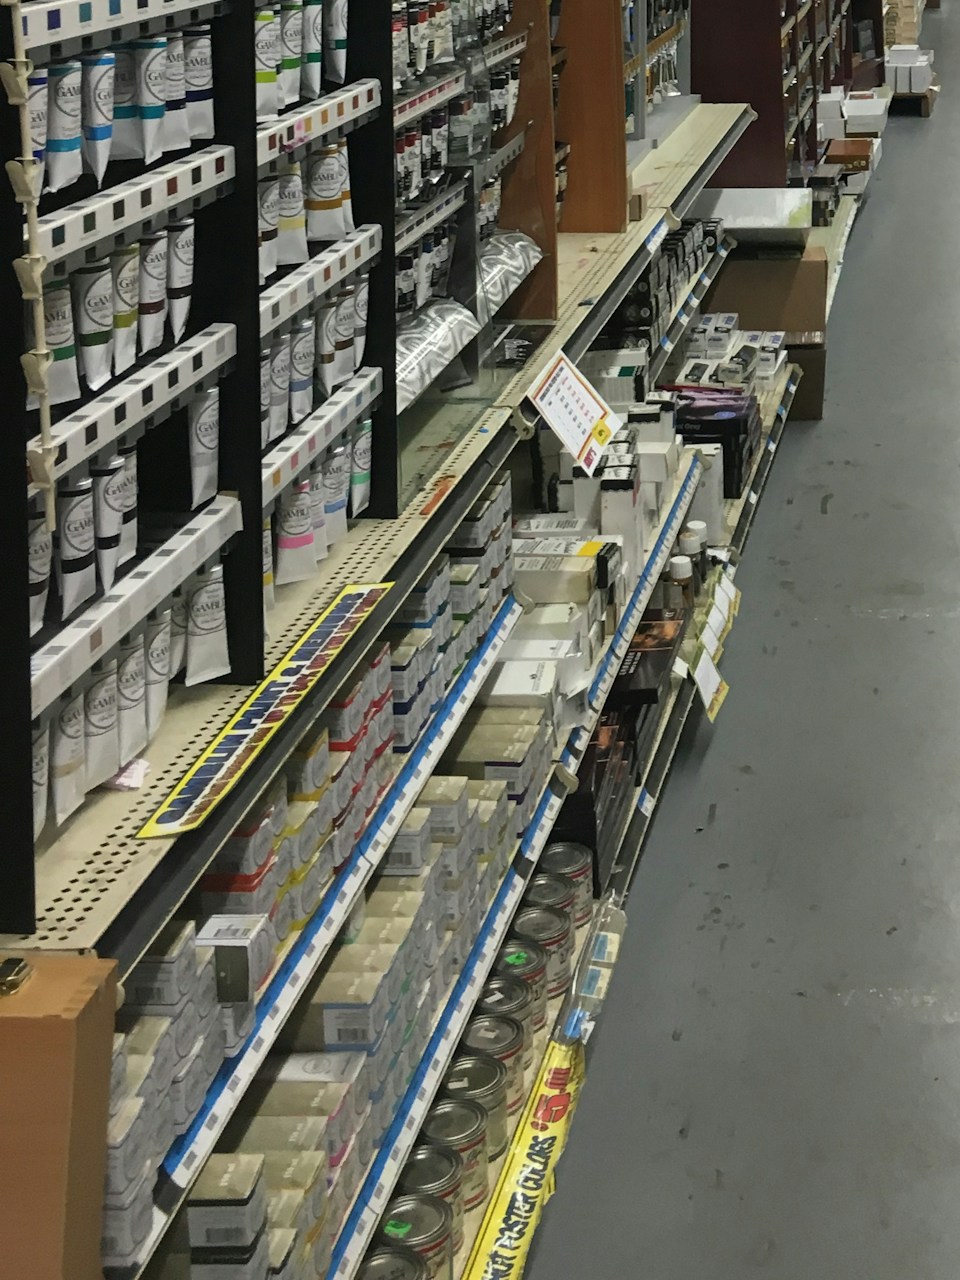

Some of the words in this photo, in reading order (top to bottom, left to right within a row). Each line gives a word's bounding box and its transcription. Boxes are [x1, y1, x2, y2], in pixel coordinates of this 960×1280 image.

[154, 732, 249, 825] GAMBLIN
[230, 679, 292, 731] PAINT
[288, 592, 366, 662] MEDIUMS
[516, 1135, 558, 1192] COLORS
